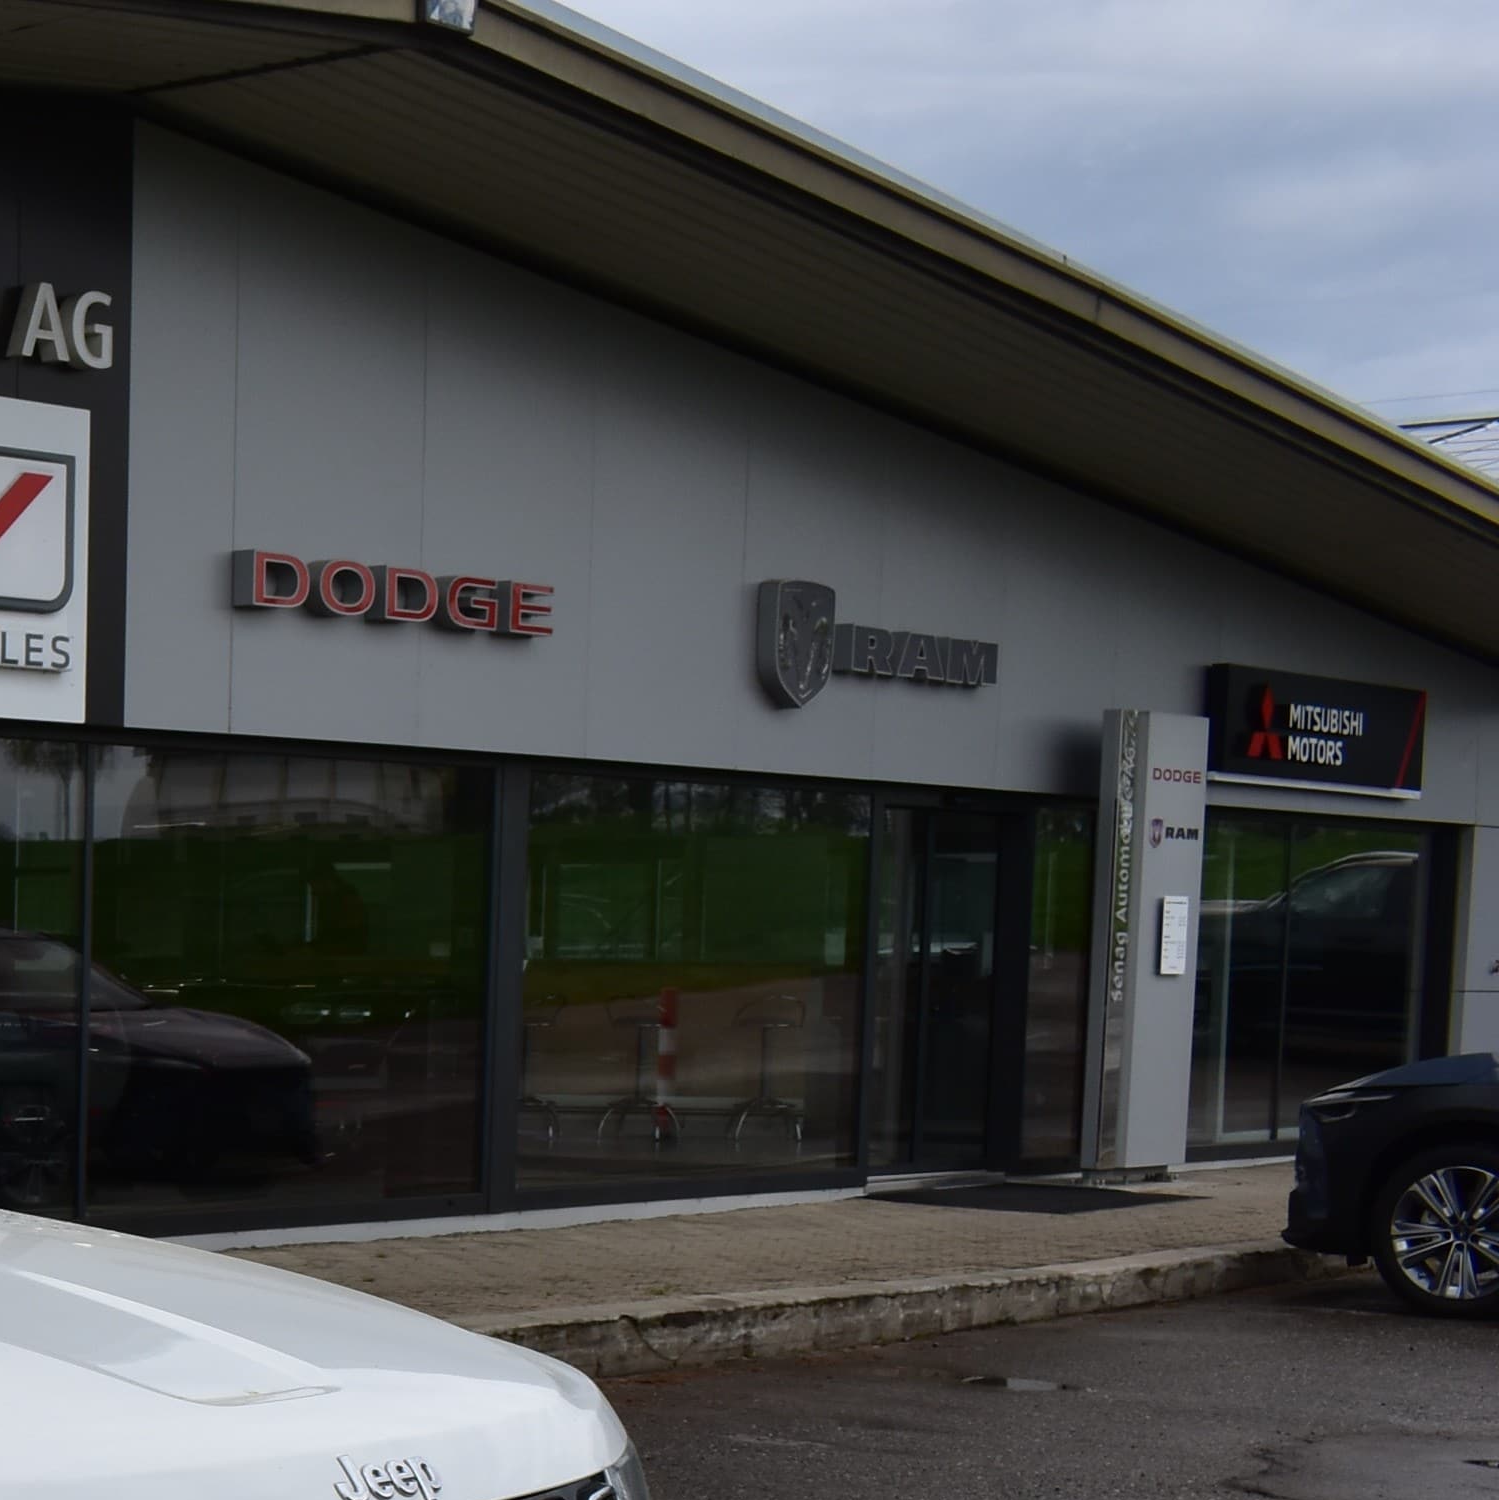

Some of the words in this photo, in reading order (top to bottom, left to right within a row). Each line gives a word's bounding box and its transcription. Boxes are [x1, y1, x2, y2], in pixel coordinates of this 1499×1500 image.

[11, 281, 115, 371] AG
[243, 549, 555, 638] DODGE
[850, 624, 999, 687] RAM
[1288, 703, 1364, 737] MITSUBISHI
[1287, 735, 1343, 767] MOTORS
[1152, 767, 1202, 785] DODGE
[1165, 826, 1200, 842] RAM
[1111, 931, 1130, 1002] Senag
